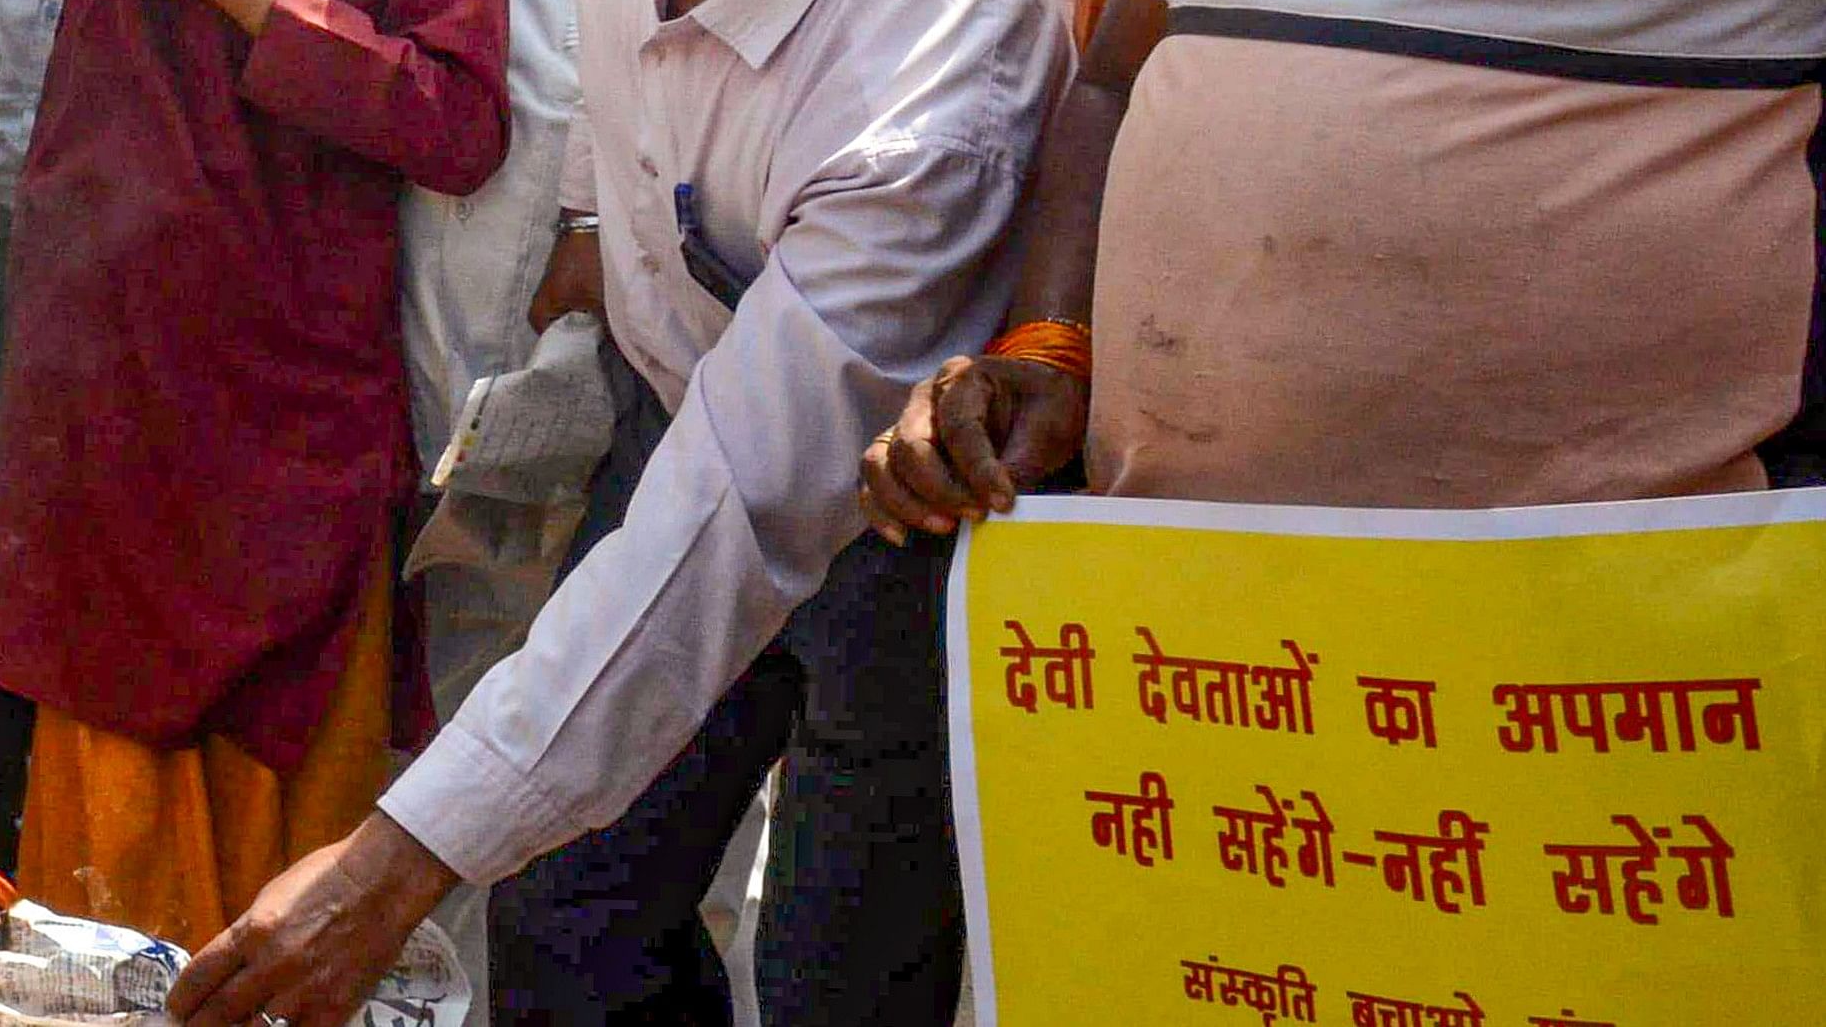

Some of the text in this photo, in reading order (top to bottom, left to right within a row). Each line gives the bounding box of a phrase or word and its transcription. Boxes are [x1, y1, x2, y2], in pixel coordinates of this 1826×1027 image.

[998, 619, 1764, 754] देवी देवताओं का अपमान
[1084, 771, 1175, 868] नही
[1543, 813, 1735, 925] सहेंगे
[1179, 956, 1317, 1027] संस्कृति
